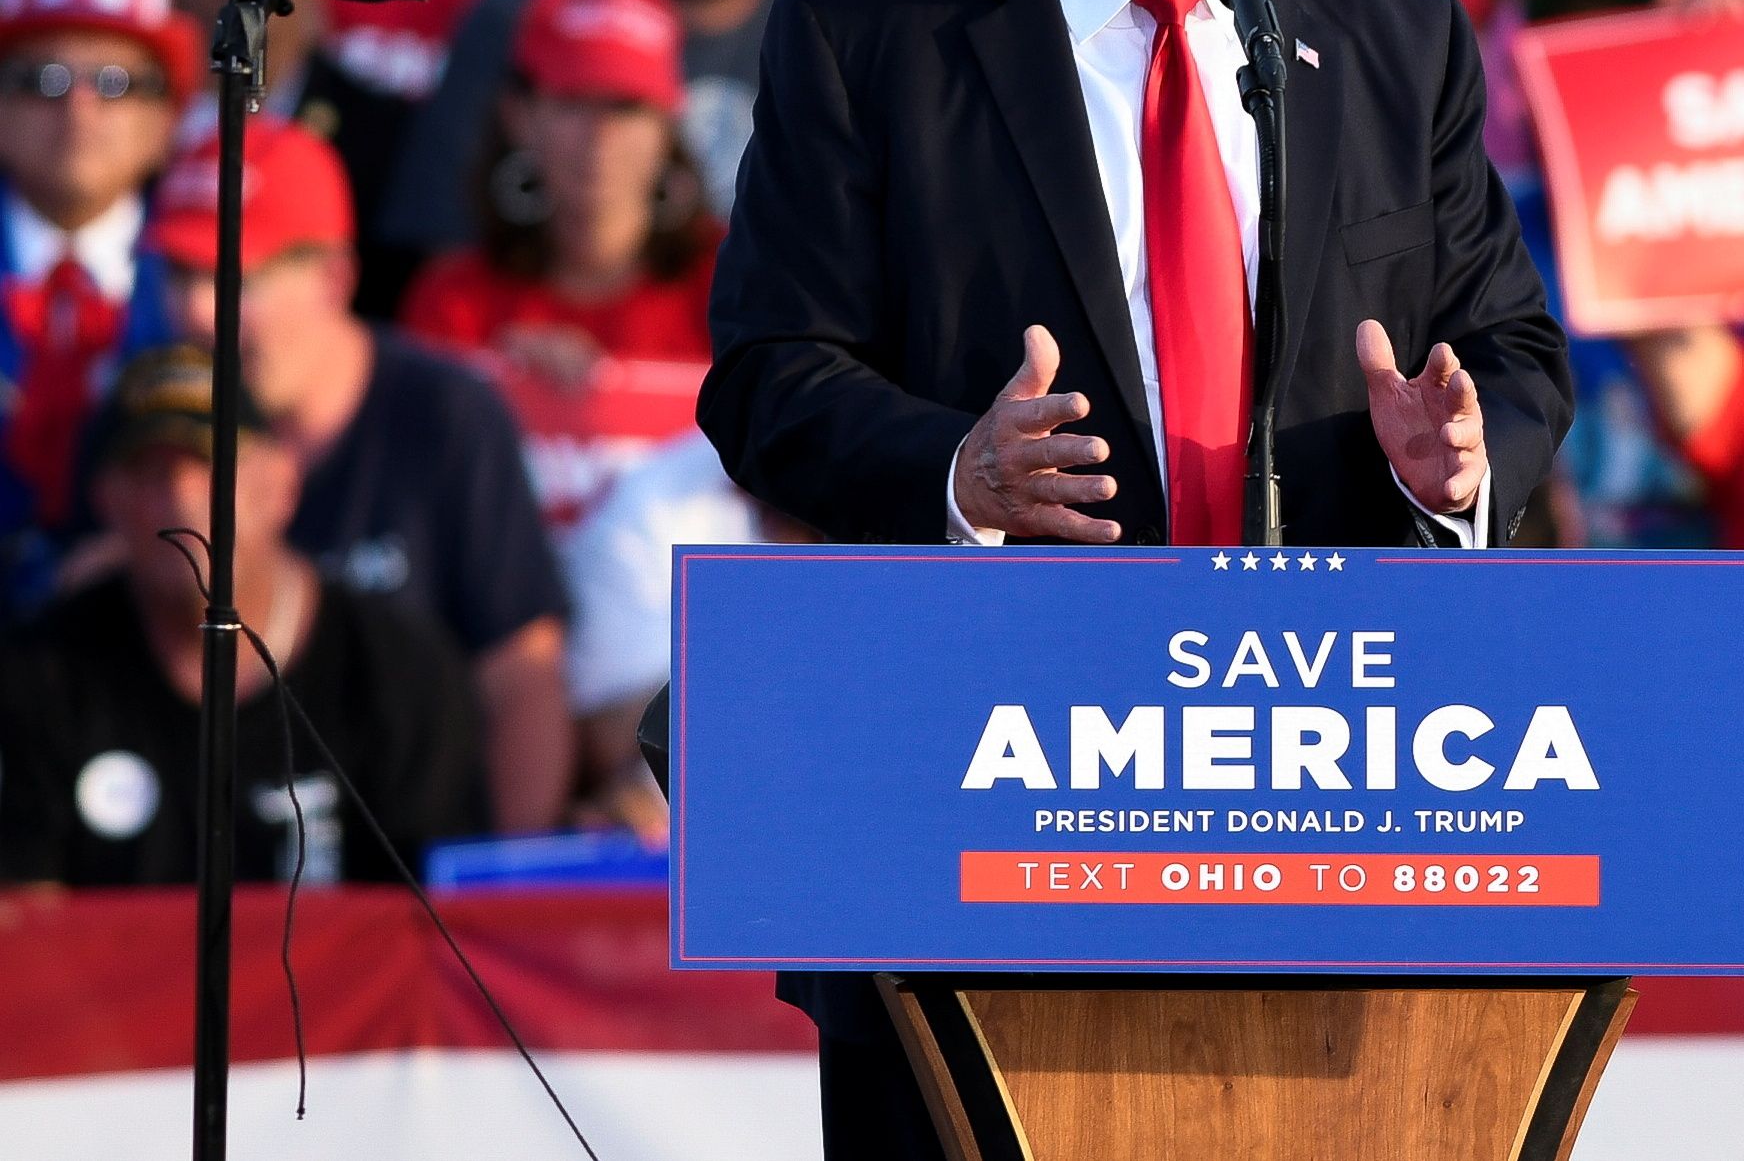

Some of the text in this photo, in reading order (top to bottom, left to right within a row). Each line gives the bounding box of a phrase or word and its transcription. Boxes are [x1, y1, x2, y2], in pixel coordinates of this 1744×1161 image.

[1167, 630, 1396, 688] SAVE
[960, 704, 1601, 791] AMERICA
[1034, 809, 1525, 833] PRESIDENT DONALD J. TRUMP
[1017, 862, 1541, 893] TEXT OHIO TO 88022
